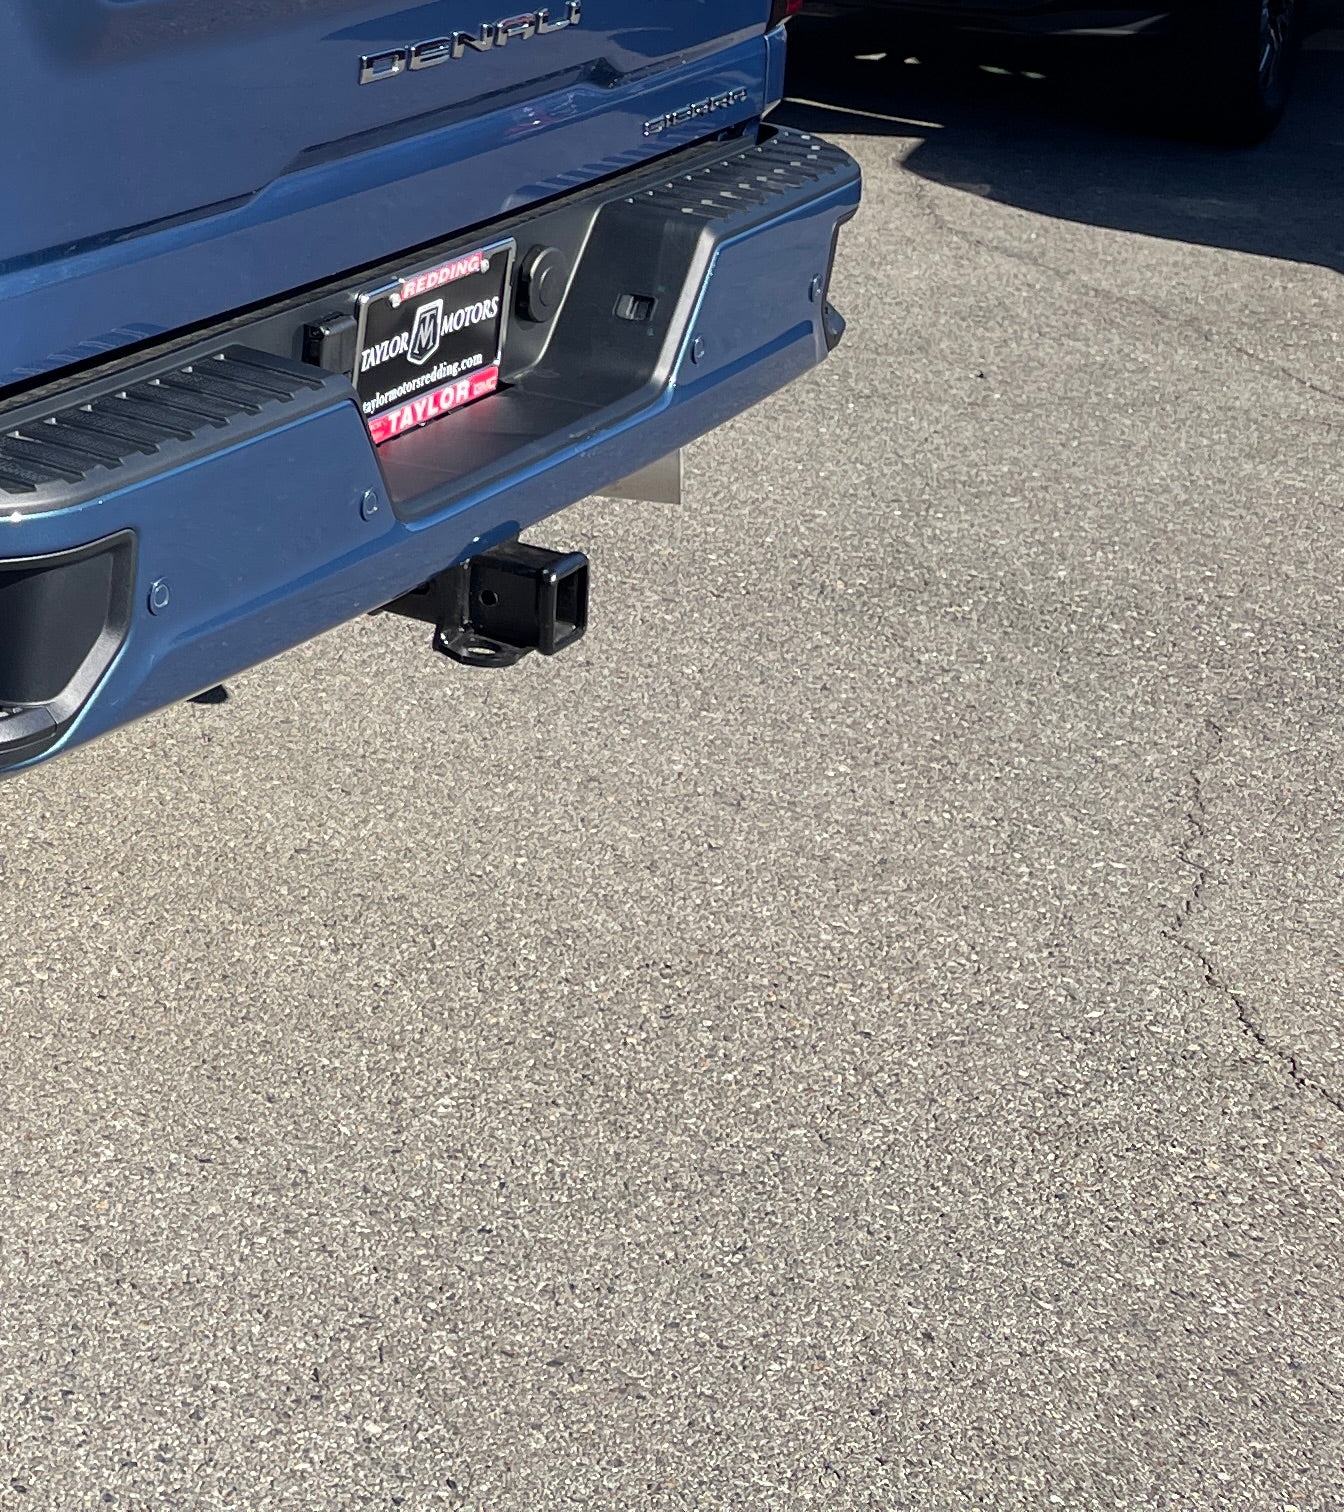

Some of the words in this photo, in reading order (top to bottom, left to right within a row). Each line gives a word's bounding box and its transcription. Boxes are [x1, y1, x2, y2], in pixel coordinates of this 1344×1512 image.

[642, 86, 748, 138] SIERRA
[402, 254, 481, 300] REDDING
[360, 331, 410, 373] TAYLOR
[440, 295, 500, 337] MOTORS
[362, 353, 483, 415] taylormotorsredding.com
[387, 379, 471, 434] TAYLOR
